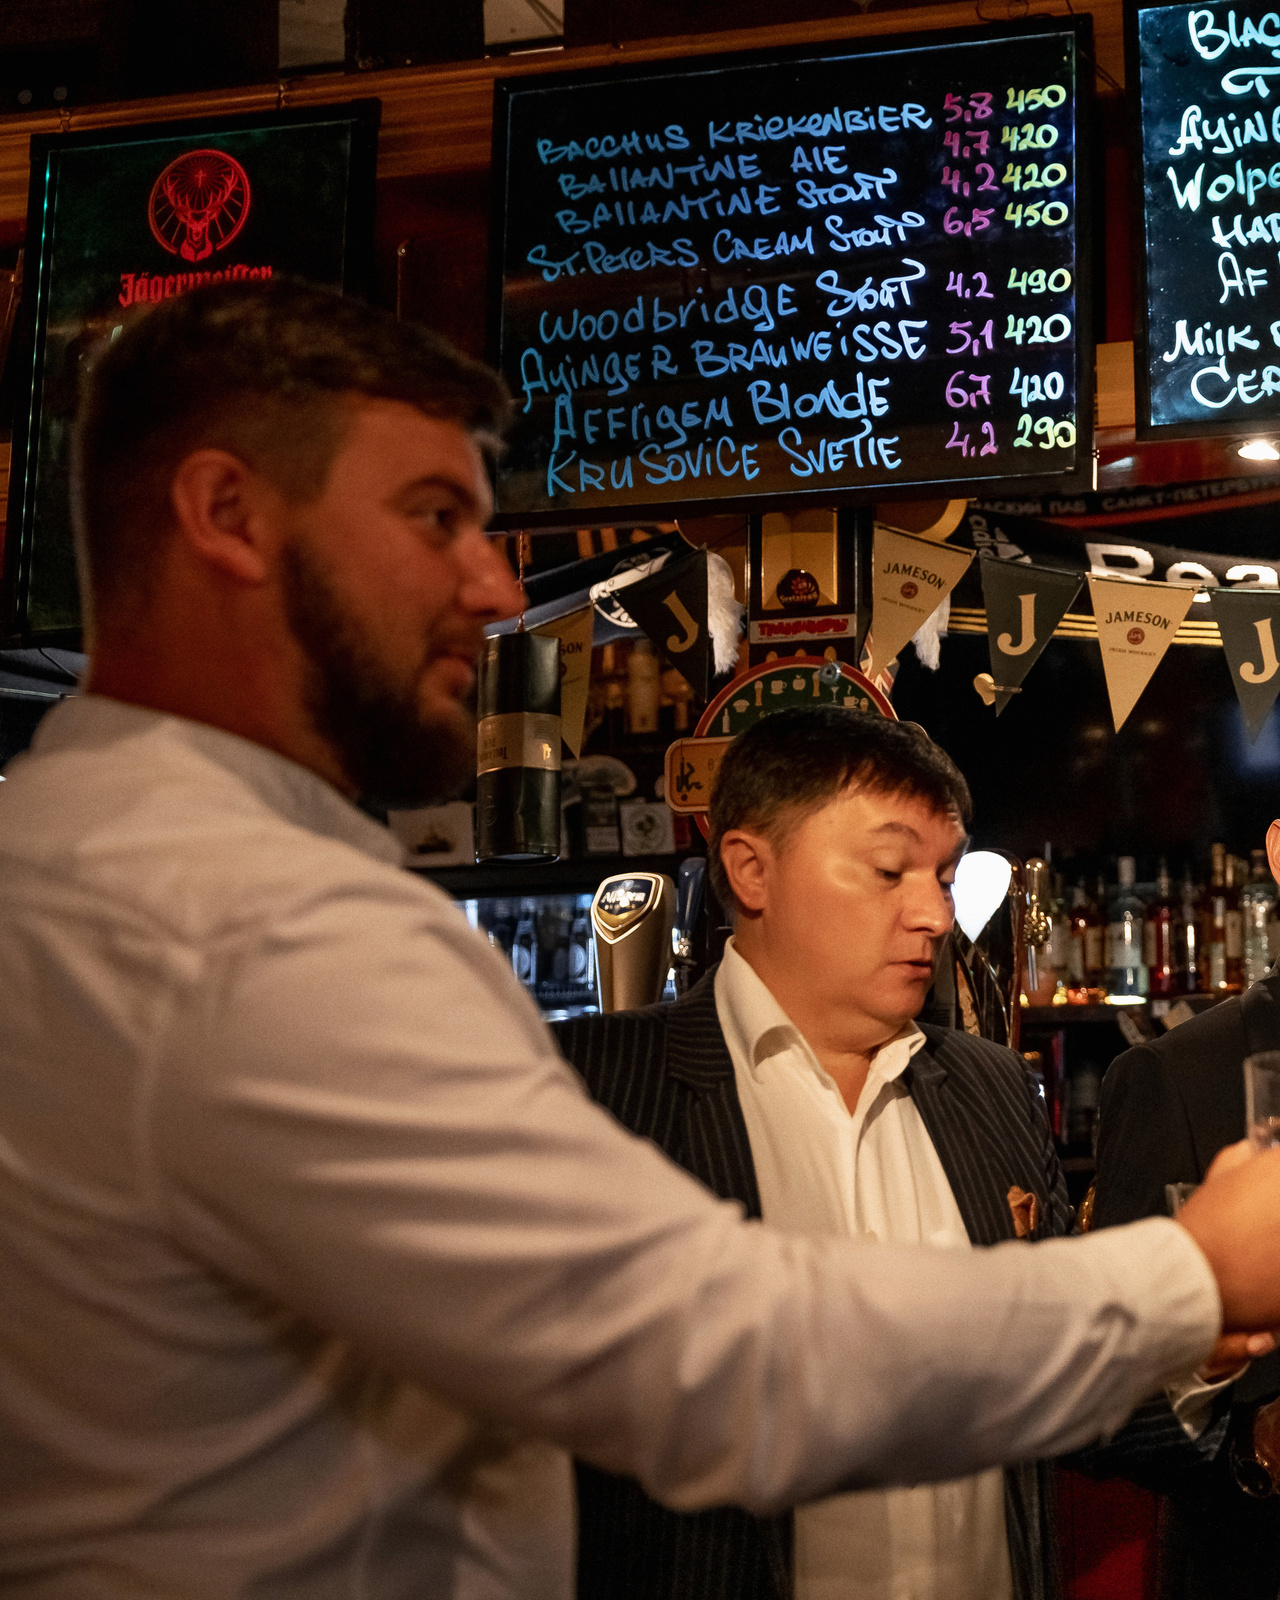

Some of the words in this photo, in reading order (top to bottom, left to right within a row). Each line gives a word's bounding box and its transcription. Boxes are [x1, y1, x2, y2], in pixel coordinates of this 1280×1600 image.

[536, 124, 690, 165] BACCHUS
[943, 92, 993, 123] 5,8
[1005, 84, 1067, 114] 450
[943, 130, 990, 158] 4,7
[1000, 123, 1059, 152] 420
[940, 162, 1000, 197] 4,2
[1002, 163, 1067, 192] 420
[712, 226, 815, 264] CREAM
[943, 206, 995, 237] 6,5
[1004, 200, 1069, 228] 450
[945, 271, 995, 299] 4,2
[1007, 267, 1072, 295] 490
[1218, 252, 1268, 303] AF
[945, 319, 994, 357] 5,1
[1004, 313, 1072, 345] 420
[945, 370, 992, 408] 6,7
[1009, 367, 1065, 408] 420
[945, 421, 998, 458] 4,2
[1013, 413, 1077, 450] 290
[883, 563, 945, 590] JAMESON
[997, 593, 1037, 656] J
[1105, 610, 1171, 630] JAMESON
[1239, 617, 1280, 685] J
